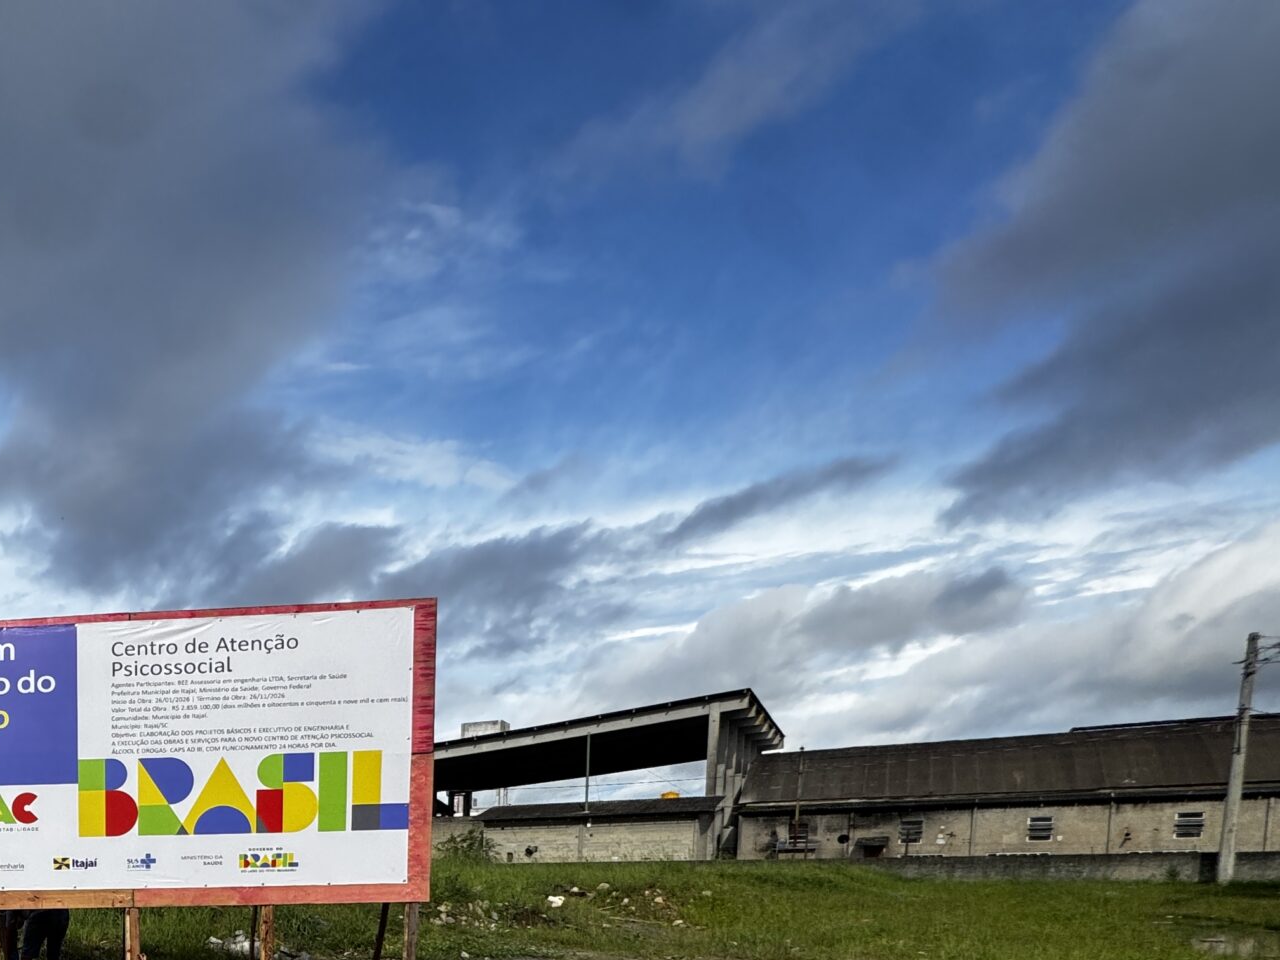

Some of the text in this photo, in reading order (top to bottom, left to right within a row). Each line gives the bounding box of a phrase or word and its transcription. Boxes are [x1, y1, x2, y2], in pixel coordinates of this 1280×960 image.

[111, 634, 299, 657] Centro de Atenção
[111, 656, 232, 677] Psicossocial
[17, 669, 56, 694] do
[78, 750, 409, 837] BRASIL
[72, 858, 98, 870] Itajaí
[239, 852, 299, 868] BRASIL
